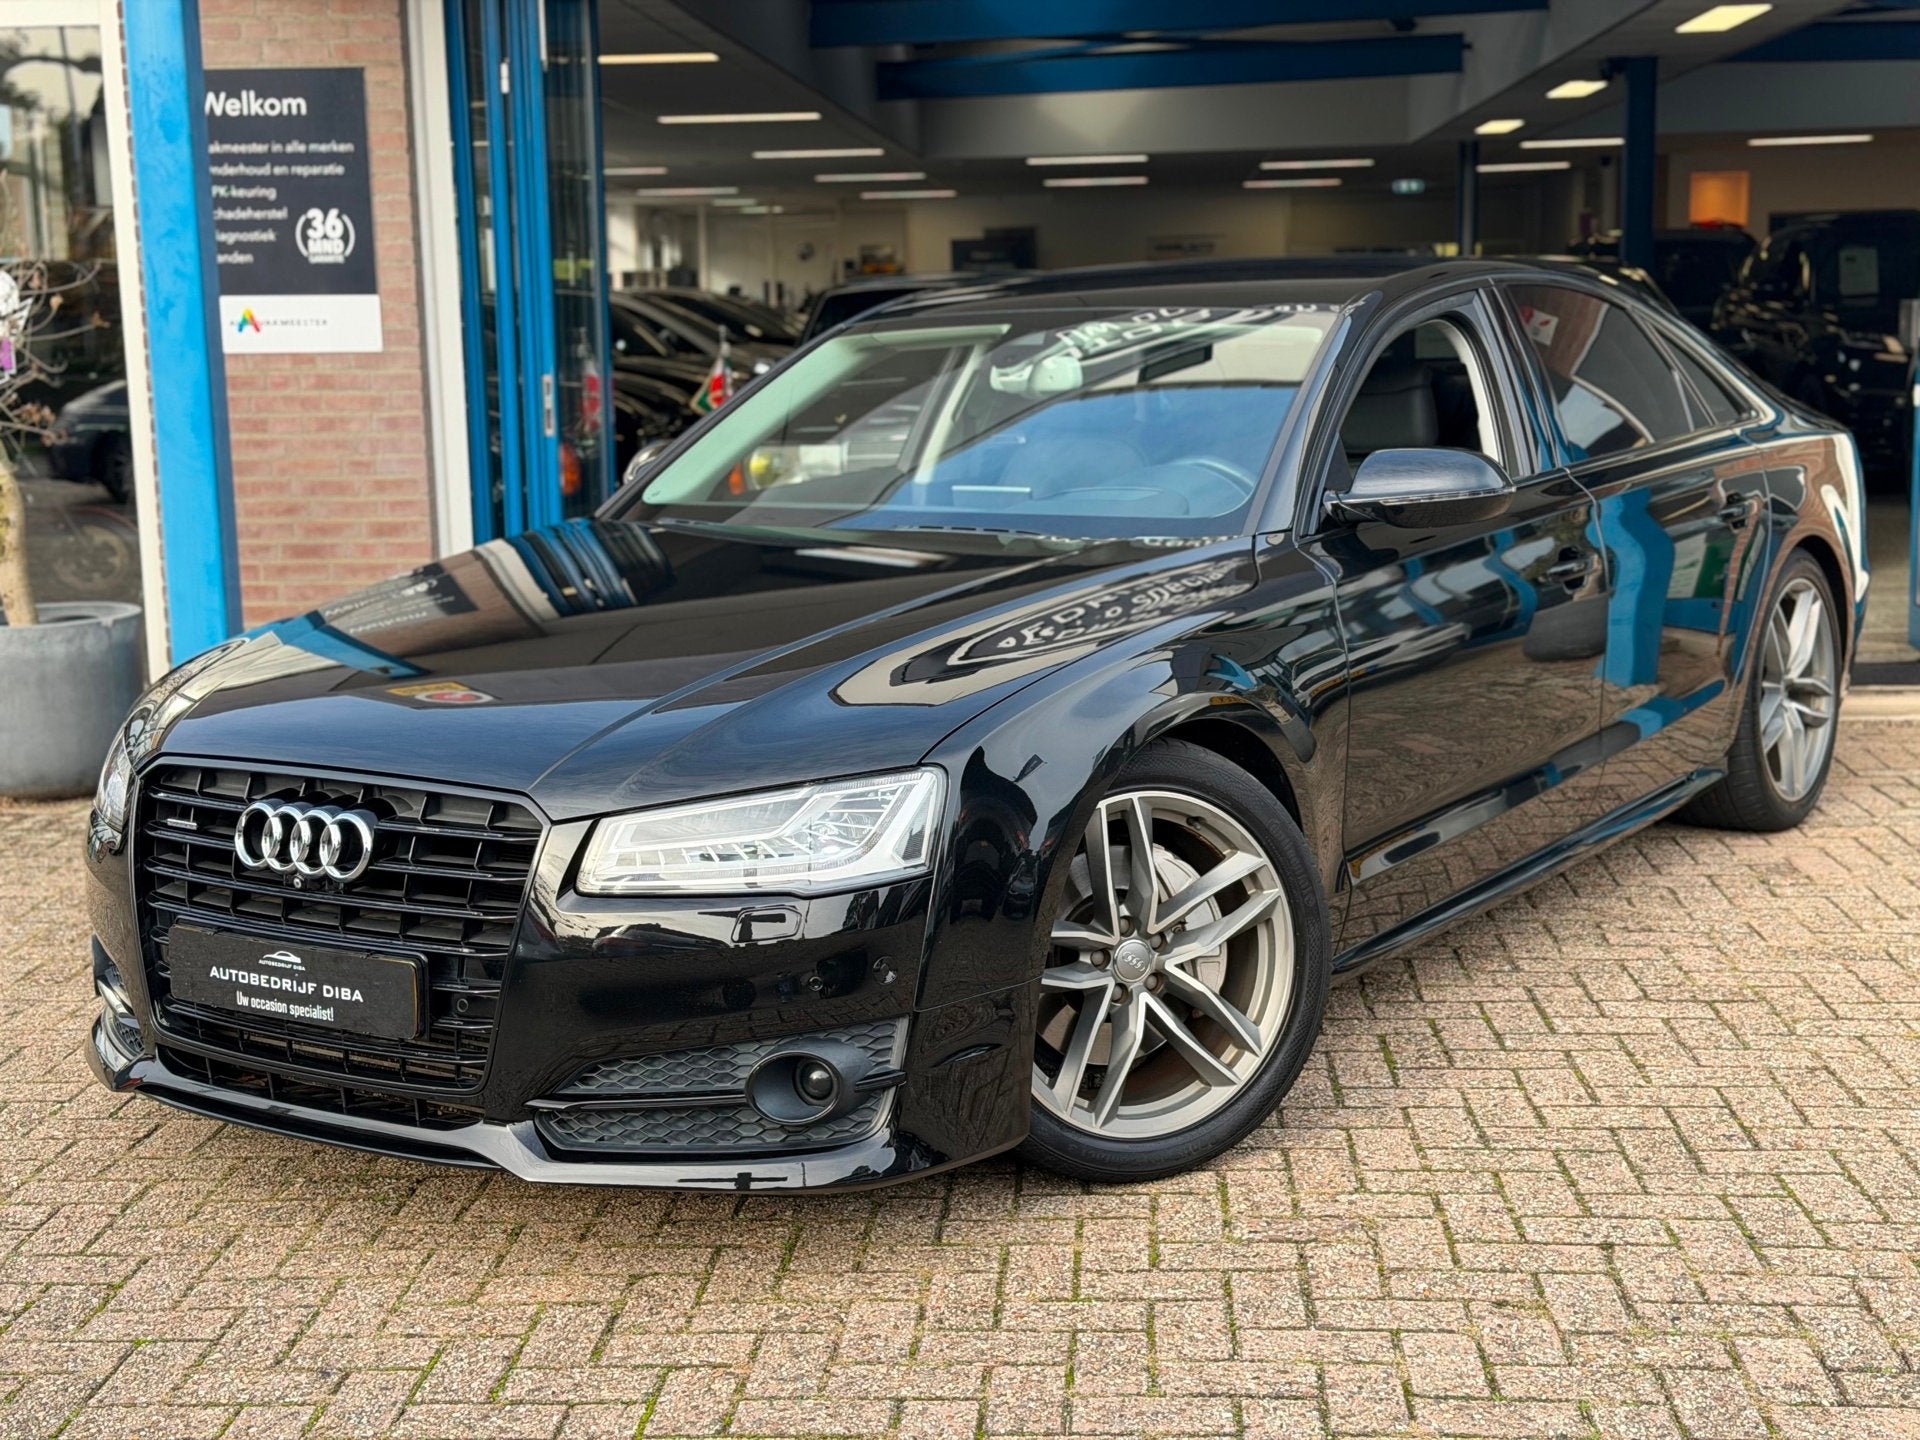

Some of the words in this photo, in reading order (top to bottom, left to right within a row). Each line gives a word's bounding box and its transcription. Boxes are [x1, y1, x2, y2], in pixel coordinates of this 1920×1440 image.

[208, 140, 269, 154] akmeester
[270, 140, 284, 154] in
[285, 139, 307, 154] alle
[308, 139, 354, 154] merken
[209, 161, 271, 176] nderhoud
[272, 164, 289, 176] en
[290, 162, 345, 178] reparatie
[211, 184, 277, 202] PK-keuring
[306, 207, 344, 240] 36
[215, 229, 276, 245] iagnostiek
[216, 250, 254, 264] anden
[258, 959, 292, 969] AUTOBEDRIJF
[209, 966, 317, 995] AUTOBEDRIJF
[322, 985, 364, 1003] DIBA
[236, 990, 249, 1006] Uw
[250, 998, 288, 1014] occasion
[289, 1004, 334, 1022] specialist!
